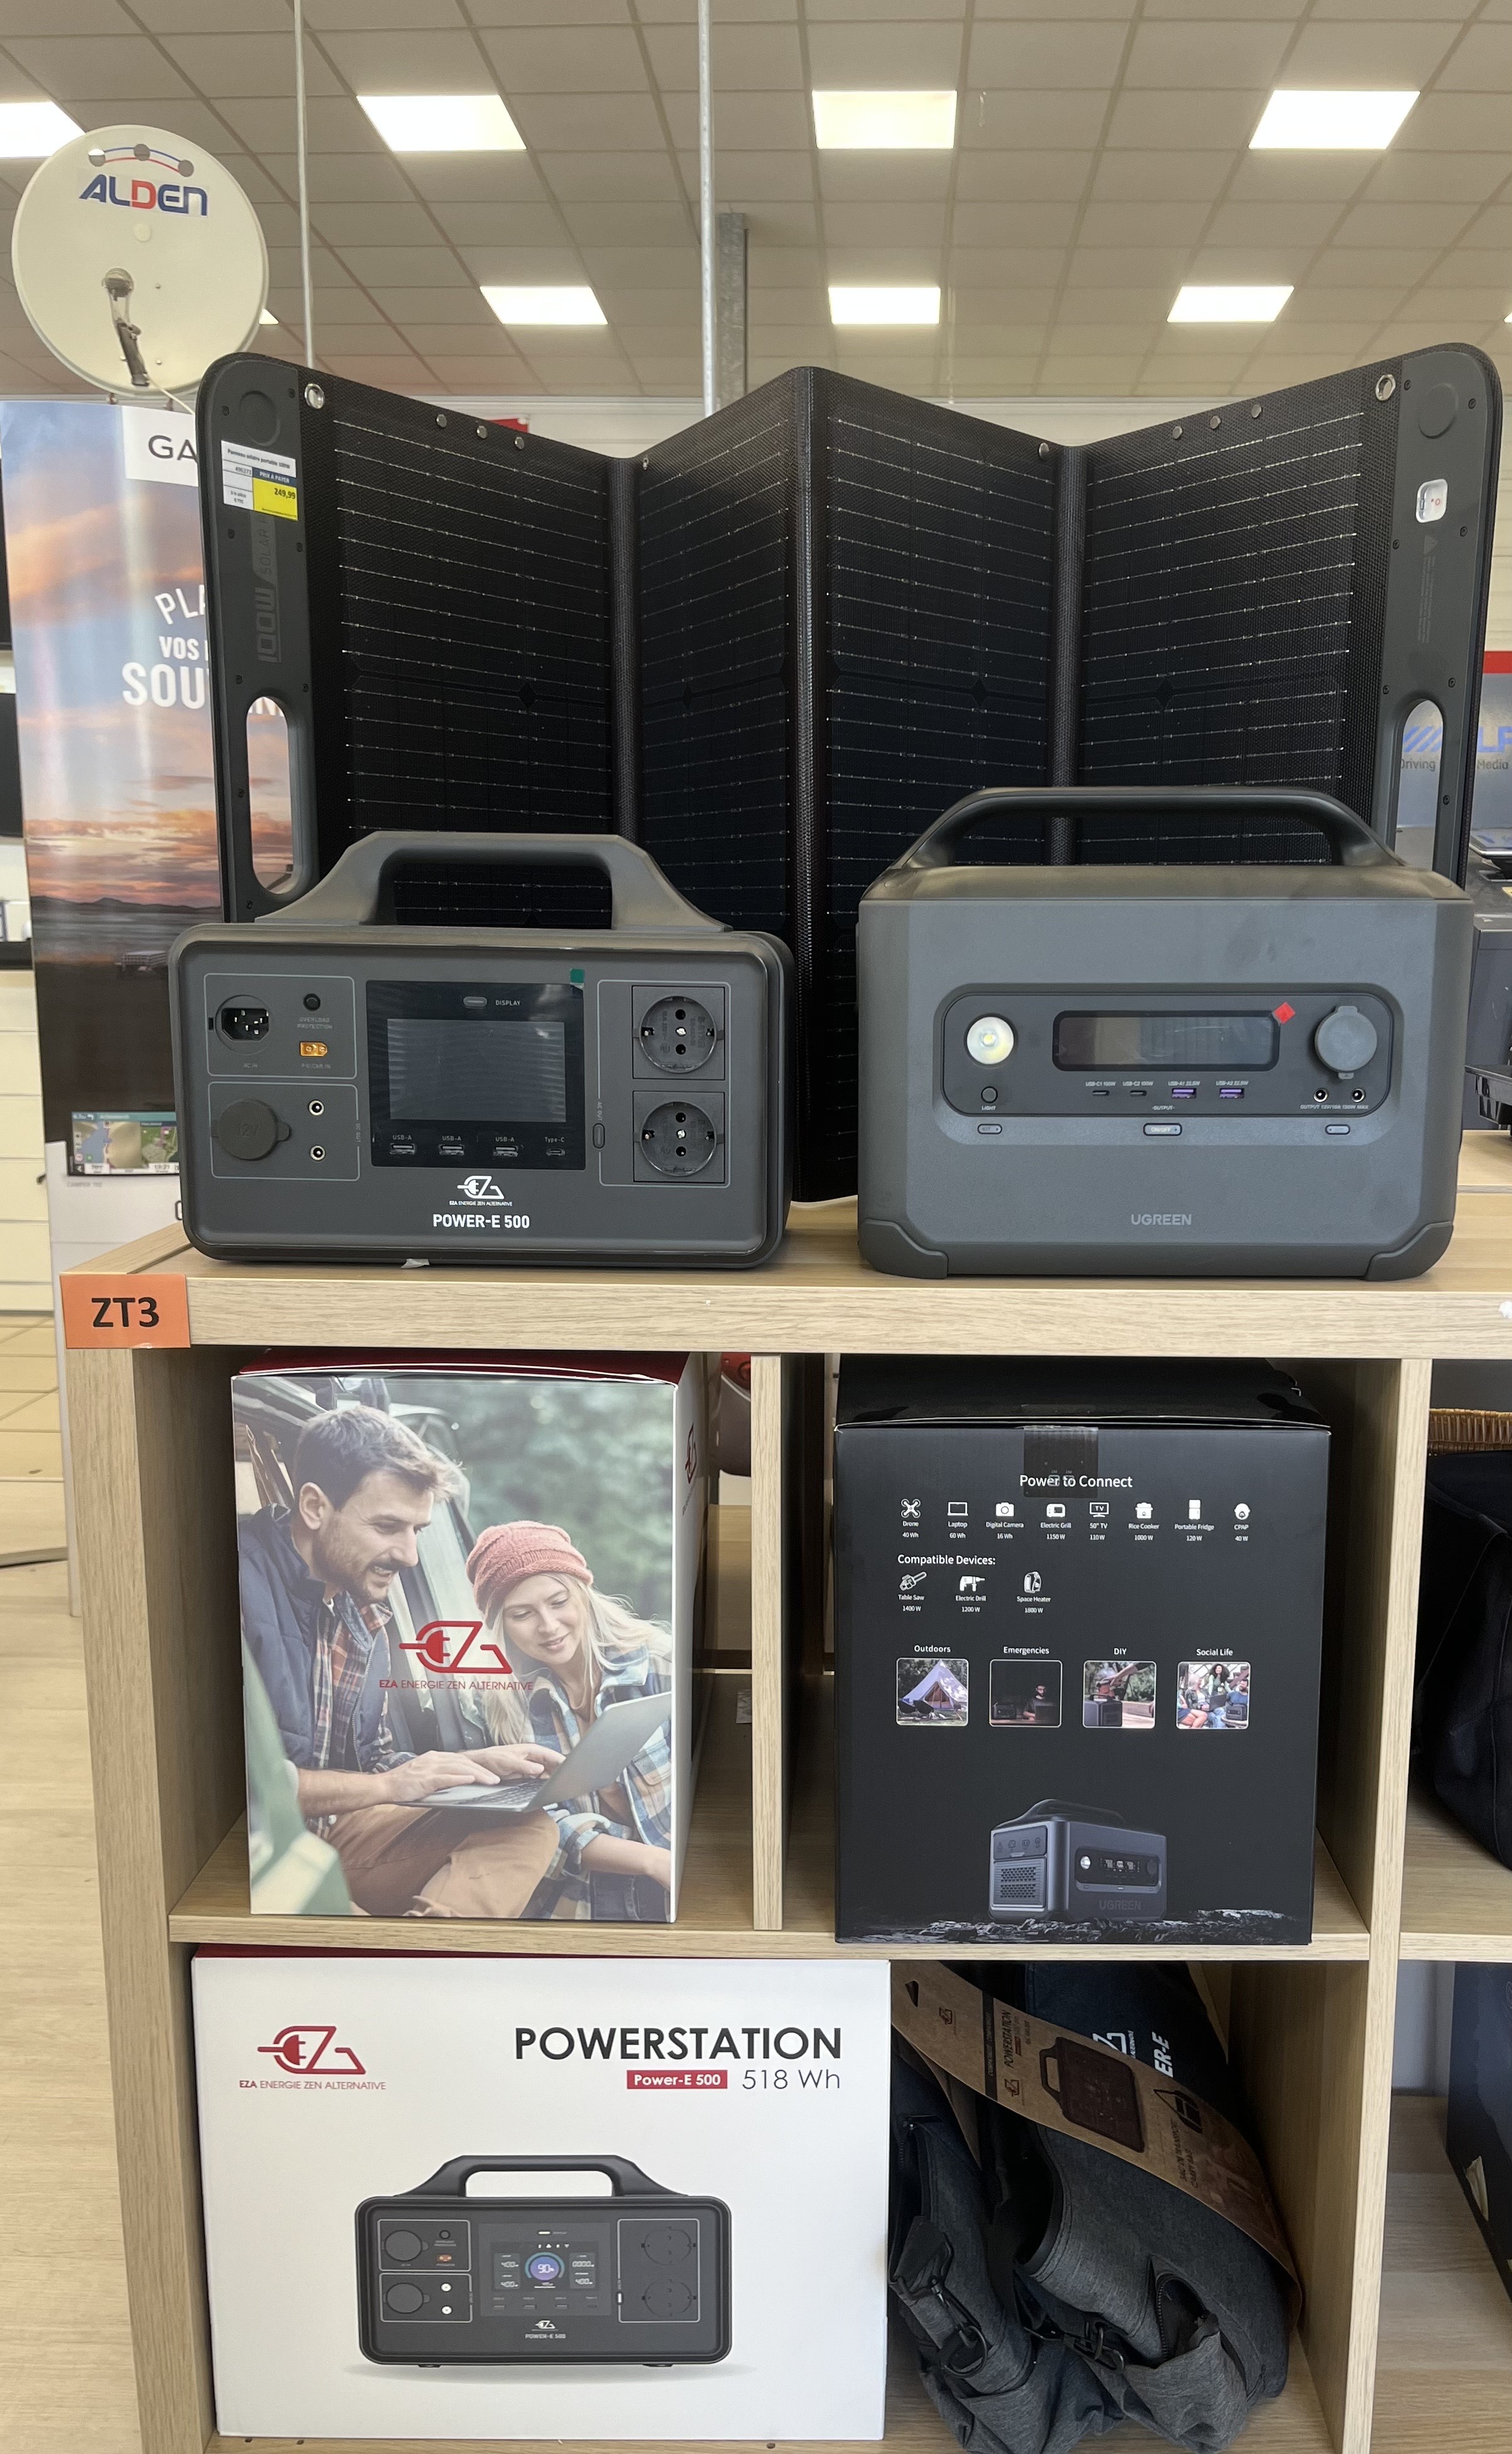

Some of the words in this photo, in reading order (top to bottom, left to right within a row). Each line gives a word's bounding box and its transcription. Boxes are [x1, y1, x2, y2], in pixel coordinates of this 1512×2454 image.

[79, 174, 208, 216] ALDEN
[274, 488, 296, 499] 249,99
[158, 636, 200, 660] VOS
[122, 662, 209, 709] SOU
[433, 1214, 501, 1228] POWER-E
[504, 1214, 530, 1229] 500
[1131, 1214, 1192, 1225] UGREEN
[91, 1296, 159, 1328] ZT3
[1020, 1475, 1059, 1487] Power
[1063, 1475, 1076, 1487] to
[1079, 1475, 1132, 1488] Connect
[897, 1554, 954, 1566] Compatible
[956, 1555, 995, 1565] Devices:
[914, 1645, 951, 1653] Outdoors
[1003, 1646, 1049, 1656] Emergencies
[1114, 1648, 1127, 1656] DIY
[1196, 1648, 1217, 1656] Social
[1219, 1648, 1233, 1656] Life
[379, 1679, 398, 1688] EZA
[401, 1680, 446, 1690] ENERGIE
[447, 1680, 466, 1690] ZEN
[469, 1681, 534, 1690] ALTERNATIVE
[1098, 1900, 1142, 1911] UGREEN
[515, 2027, 841, 2060] POWERSTATION
[1151, 2031, 1173, 2077] ER-E
[239, 2079, 258, 2088] EZA
[260, 2081, 302, 2089] ENERGIE
[304, 2081, 322, 2089] ZEN
[324, 2081, 386, 2090] ALTERNATIVE
[633, 2074, 693, 2086] Power-E
[695, 2074, 721, 2086] 500
[742, 2069, 788, 2089] 518
[798, 2069, 840, 2089] Wh
